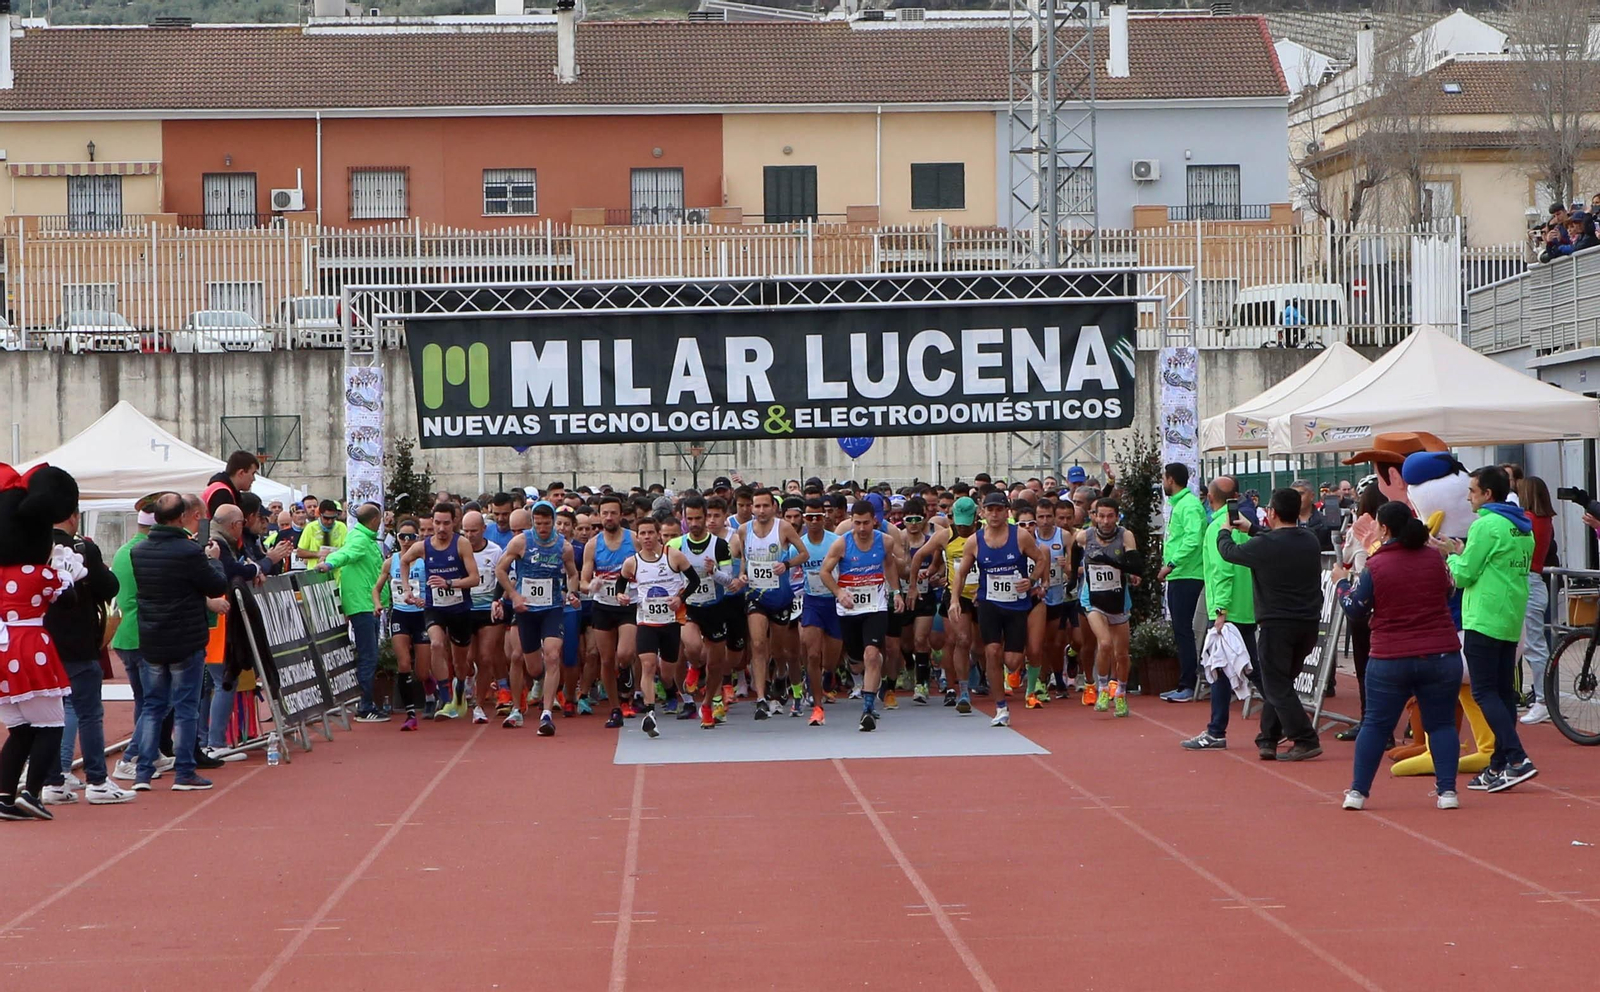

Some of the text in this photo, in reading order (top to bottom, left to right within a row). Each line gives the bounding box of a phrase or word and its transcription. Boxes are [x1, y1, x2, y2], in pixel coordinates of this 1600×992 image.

[511, 325, 1120, 409] MILAR LUCENA
[422, 397, 1122, 437] NUEVAS TECNOLOGÍAS & ELECTRODOMÉSTICOS
[753, 568, 773, 580] 925
[1096, 571, 1114, 582] 610
[530, 586, 544, 598] 30
[993, 581, 1012, 593] 916
[852, 593, 872, 605] 361
[648, 603, 669, 616] 933
